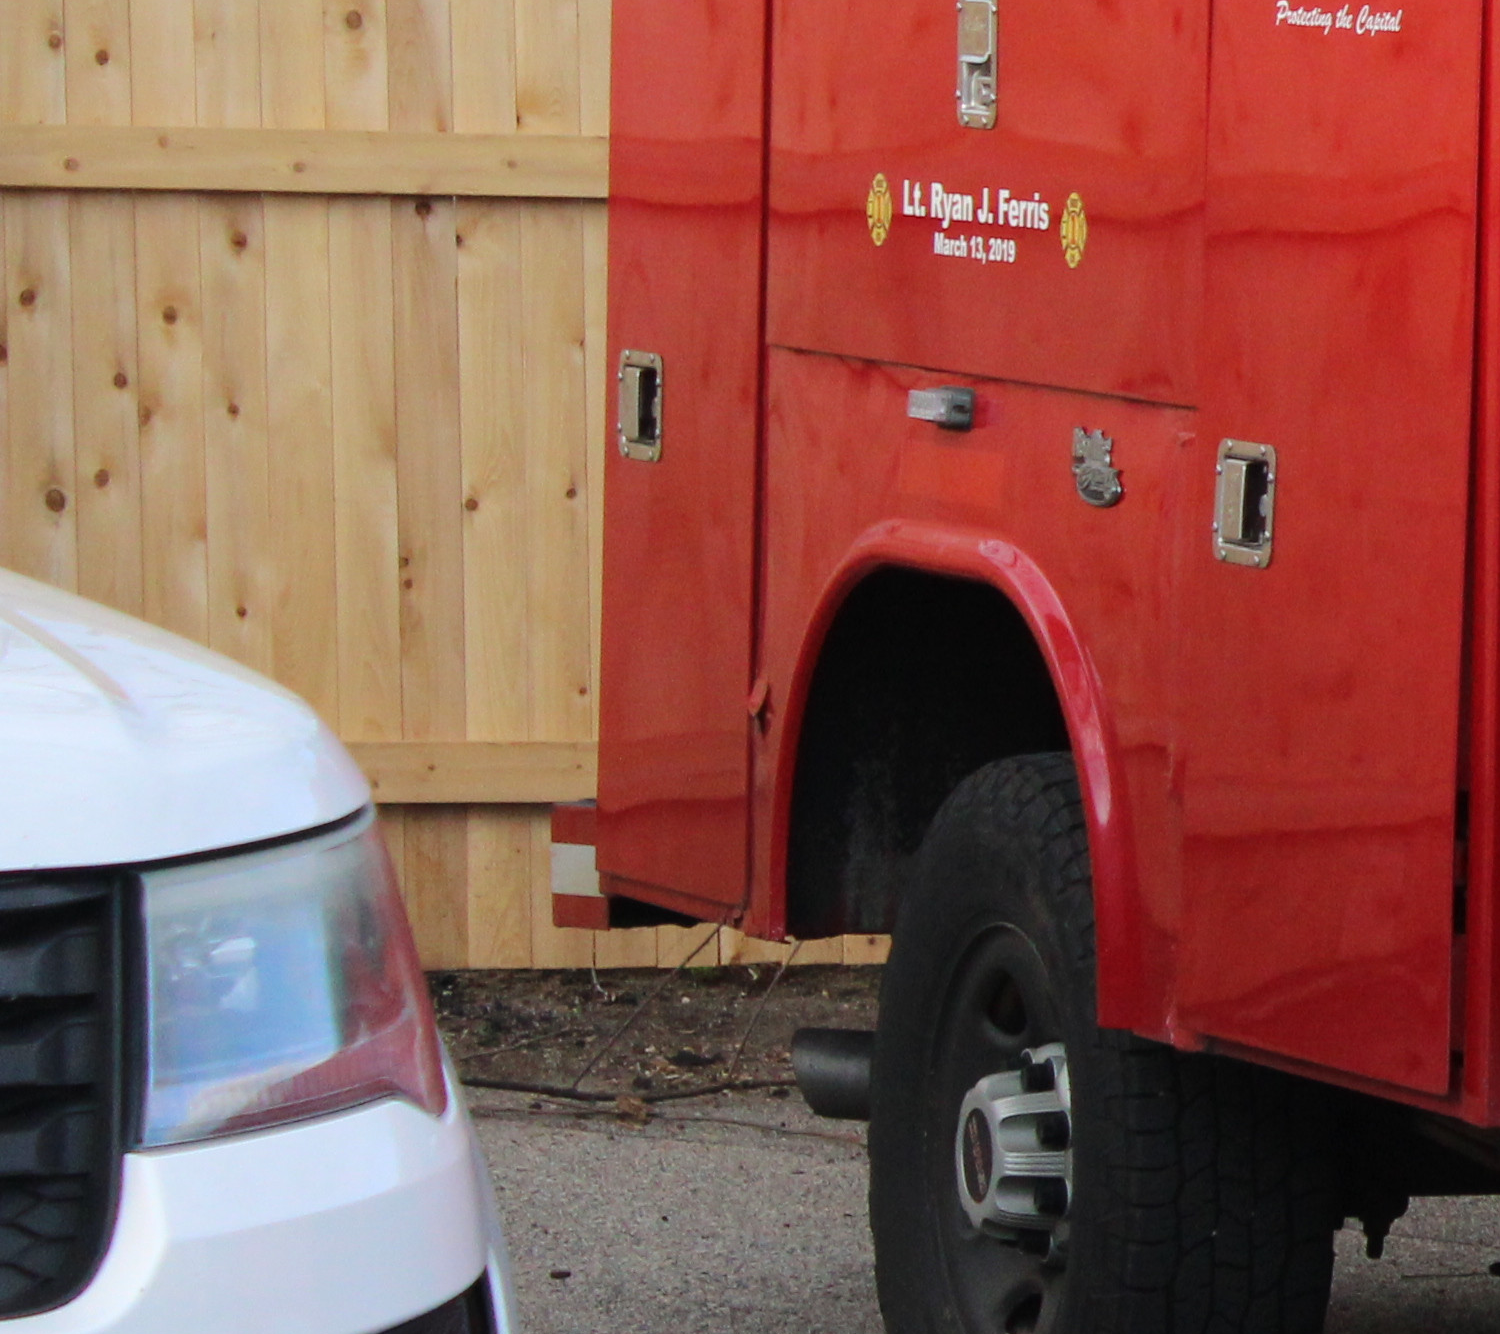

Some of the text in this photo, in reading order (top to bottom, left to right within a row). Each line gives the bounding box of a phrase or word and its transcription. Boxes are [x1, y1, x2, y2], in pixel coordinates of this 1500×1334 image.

[1335, 4, 1355, 30] the
[1355, 4, 1404, 38] Capital
[902, 178, 1051, 231] Lt. Ryan J. Ferris
[933, 231, 1017, 265] March 13, 2019
